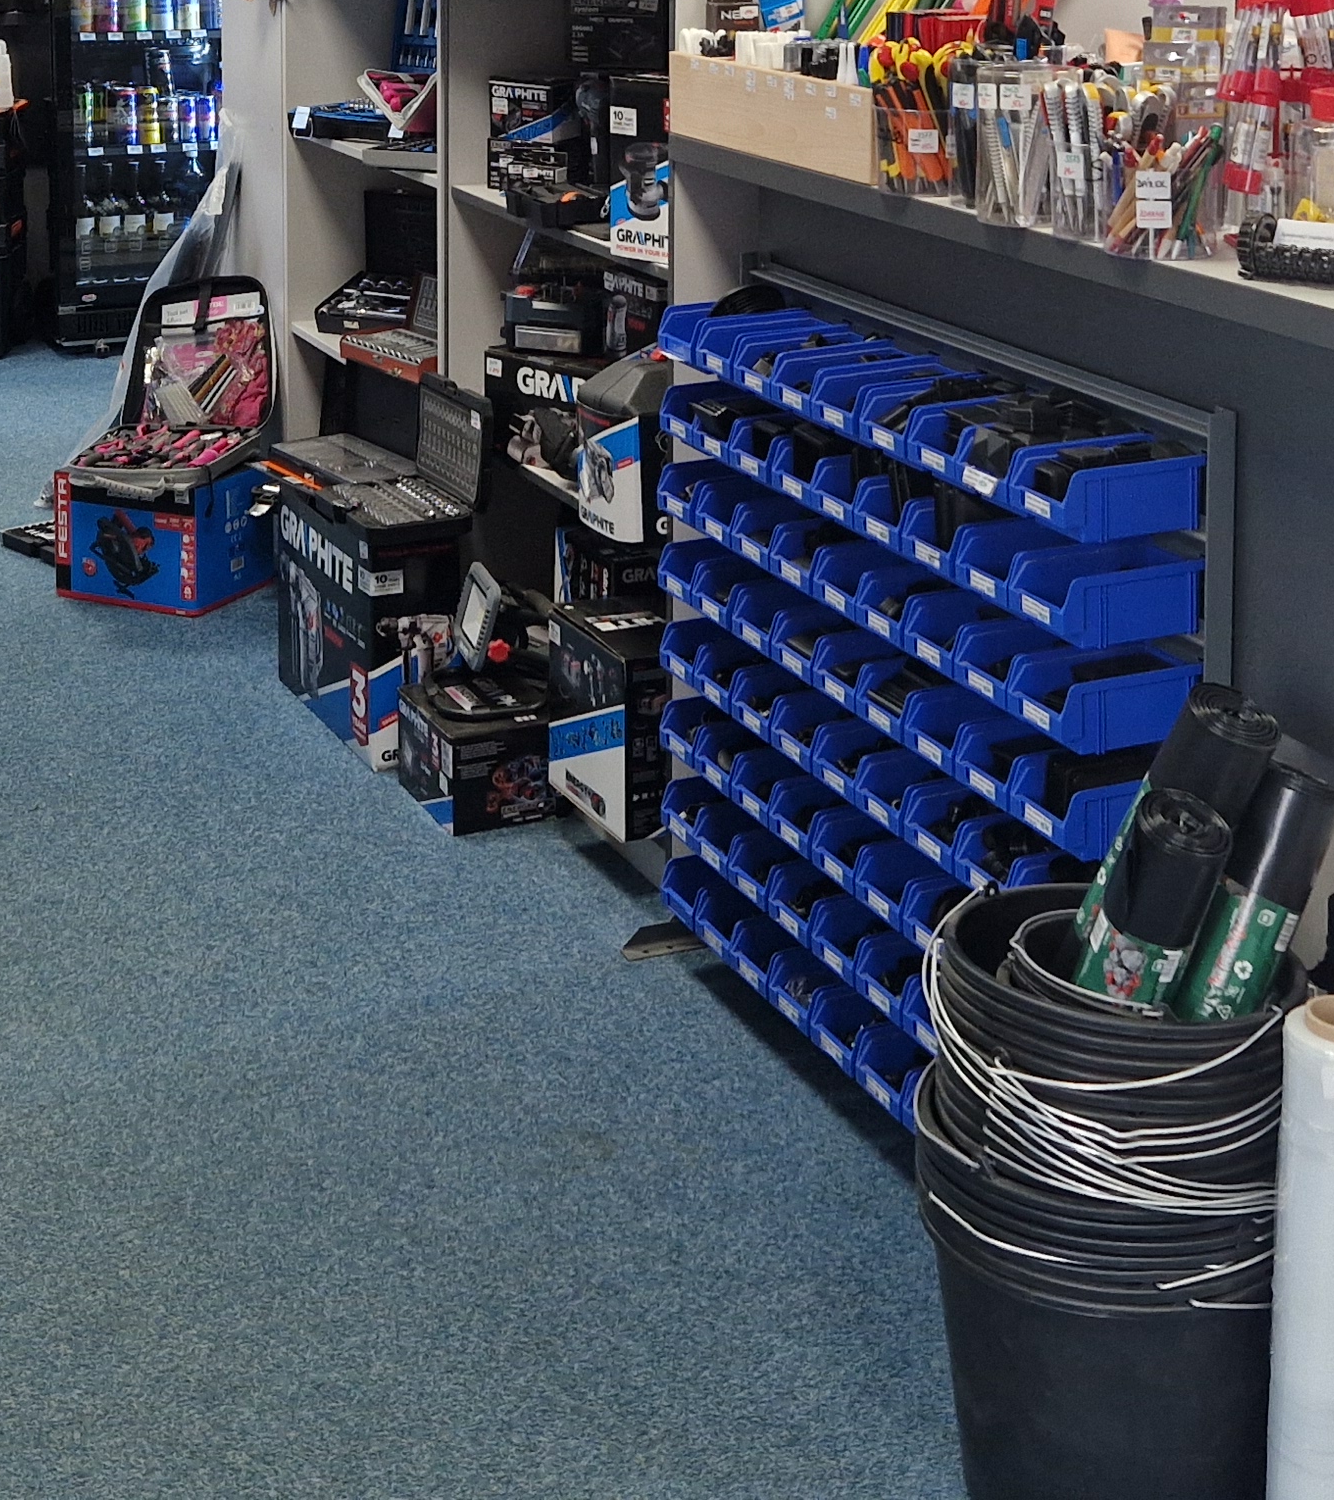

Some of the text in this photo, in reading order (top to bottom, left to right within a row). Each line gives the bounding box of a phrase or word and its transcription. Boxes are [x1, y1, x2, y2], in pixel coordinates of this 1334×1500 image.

[491, 84, 547, 101] GRAPHITE
[612, 110, 624, 121] 10
[616, 244, 636, 254] POWER
[57, 477, 68, 559] FESTA
[580, 504, 615, 534] GRAPHITE
[280, 504, 354, 595] GRAPHITE
[374, 573, 387, 584] 10
[352, 668, 367, 718] 3
